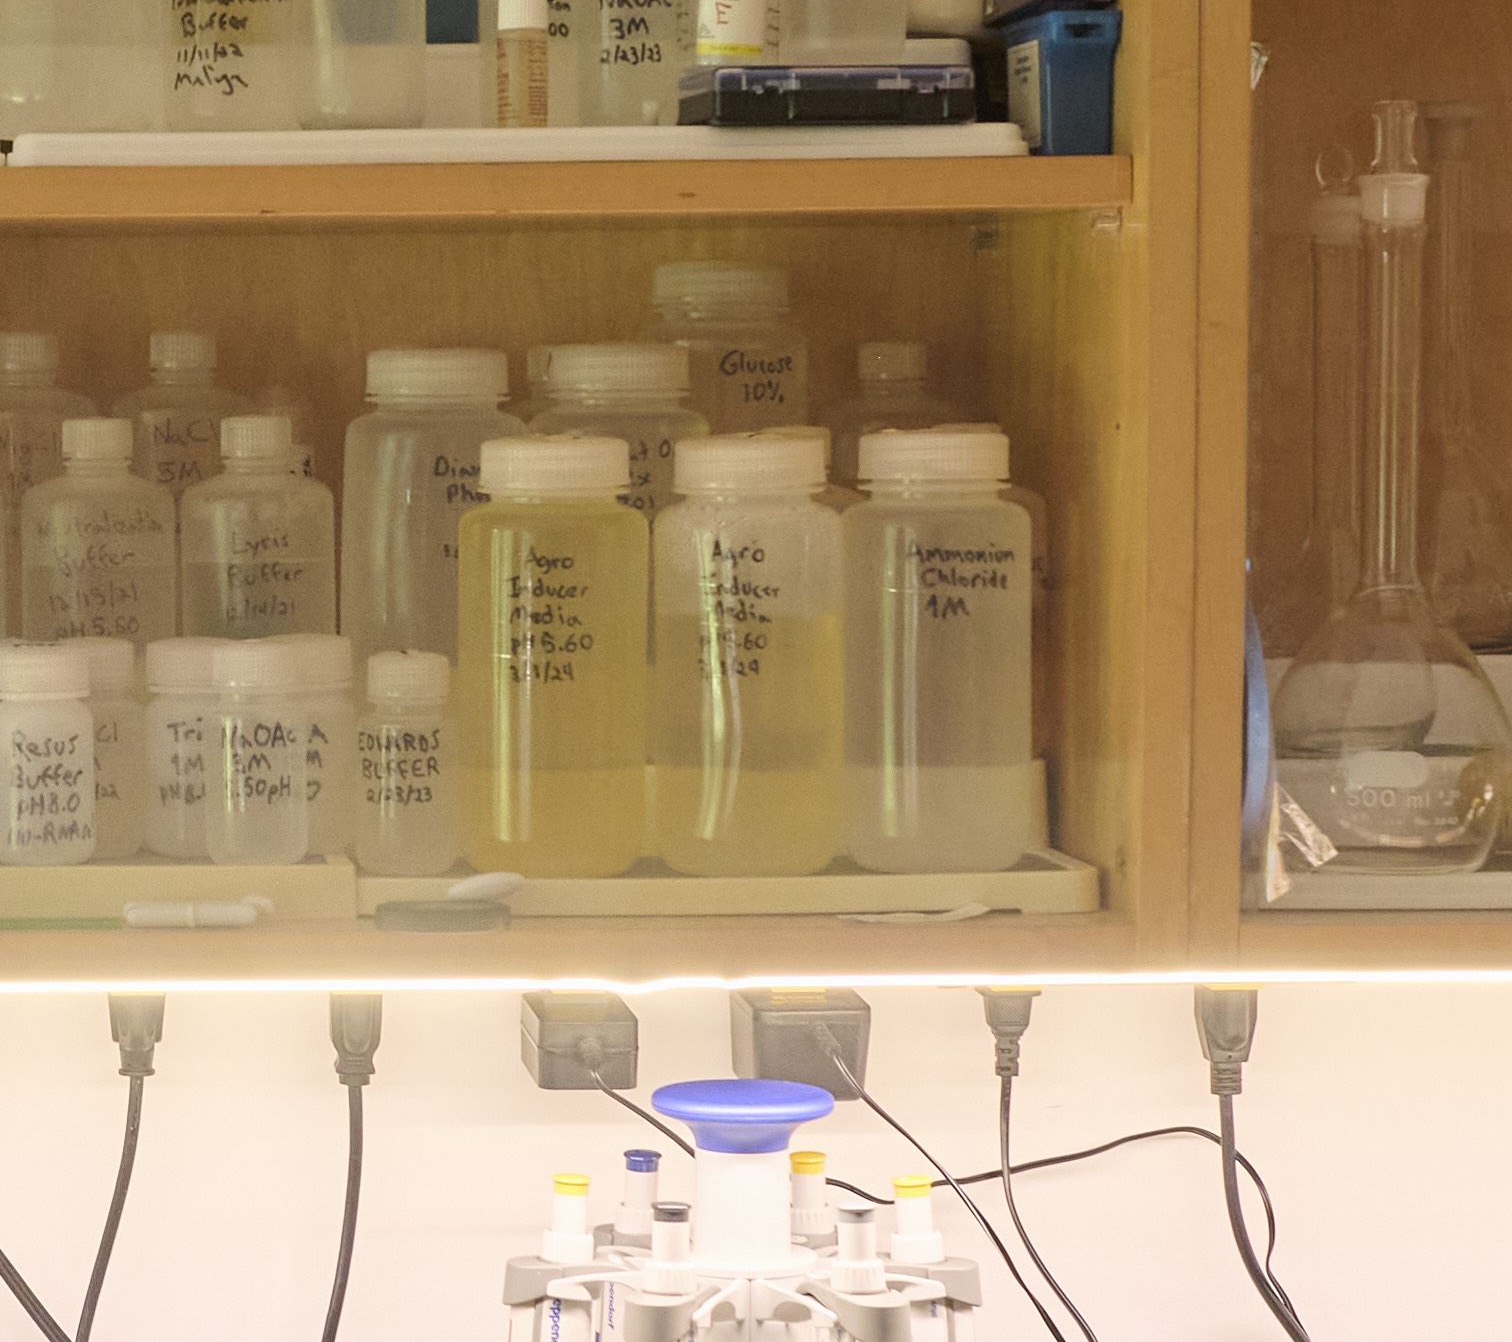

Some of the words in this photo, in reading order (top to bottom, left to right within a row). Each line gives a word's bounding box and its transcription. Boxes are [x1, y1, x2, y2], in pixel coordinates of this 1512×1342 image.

[610, 17, 649, 36] 3M
[720, 349, 794, 377] Glucose
[742, 379, 786, 403] 10%
[710, 542, 766, 566] Agro
[921, 566, 1009, 590] Chloride
[509, 604, 584, 627] Media
[924, 595, 970, 618] 1M
[362, 758, 441, 779] BUFFER
